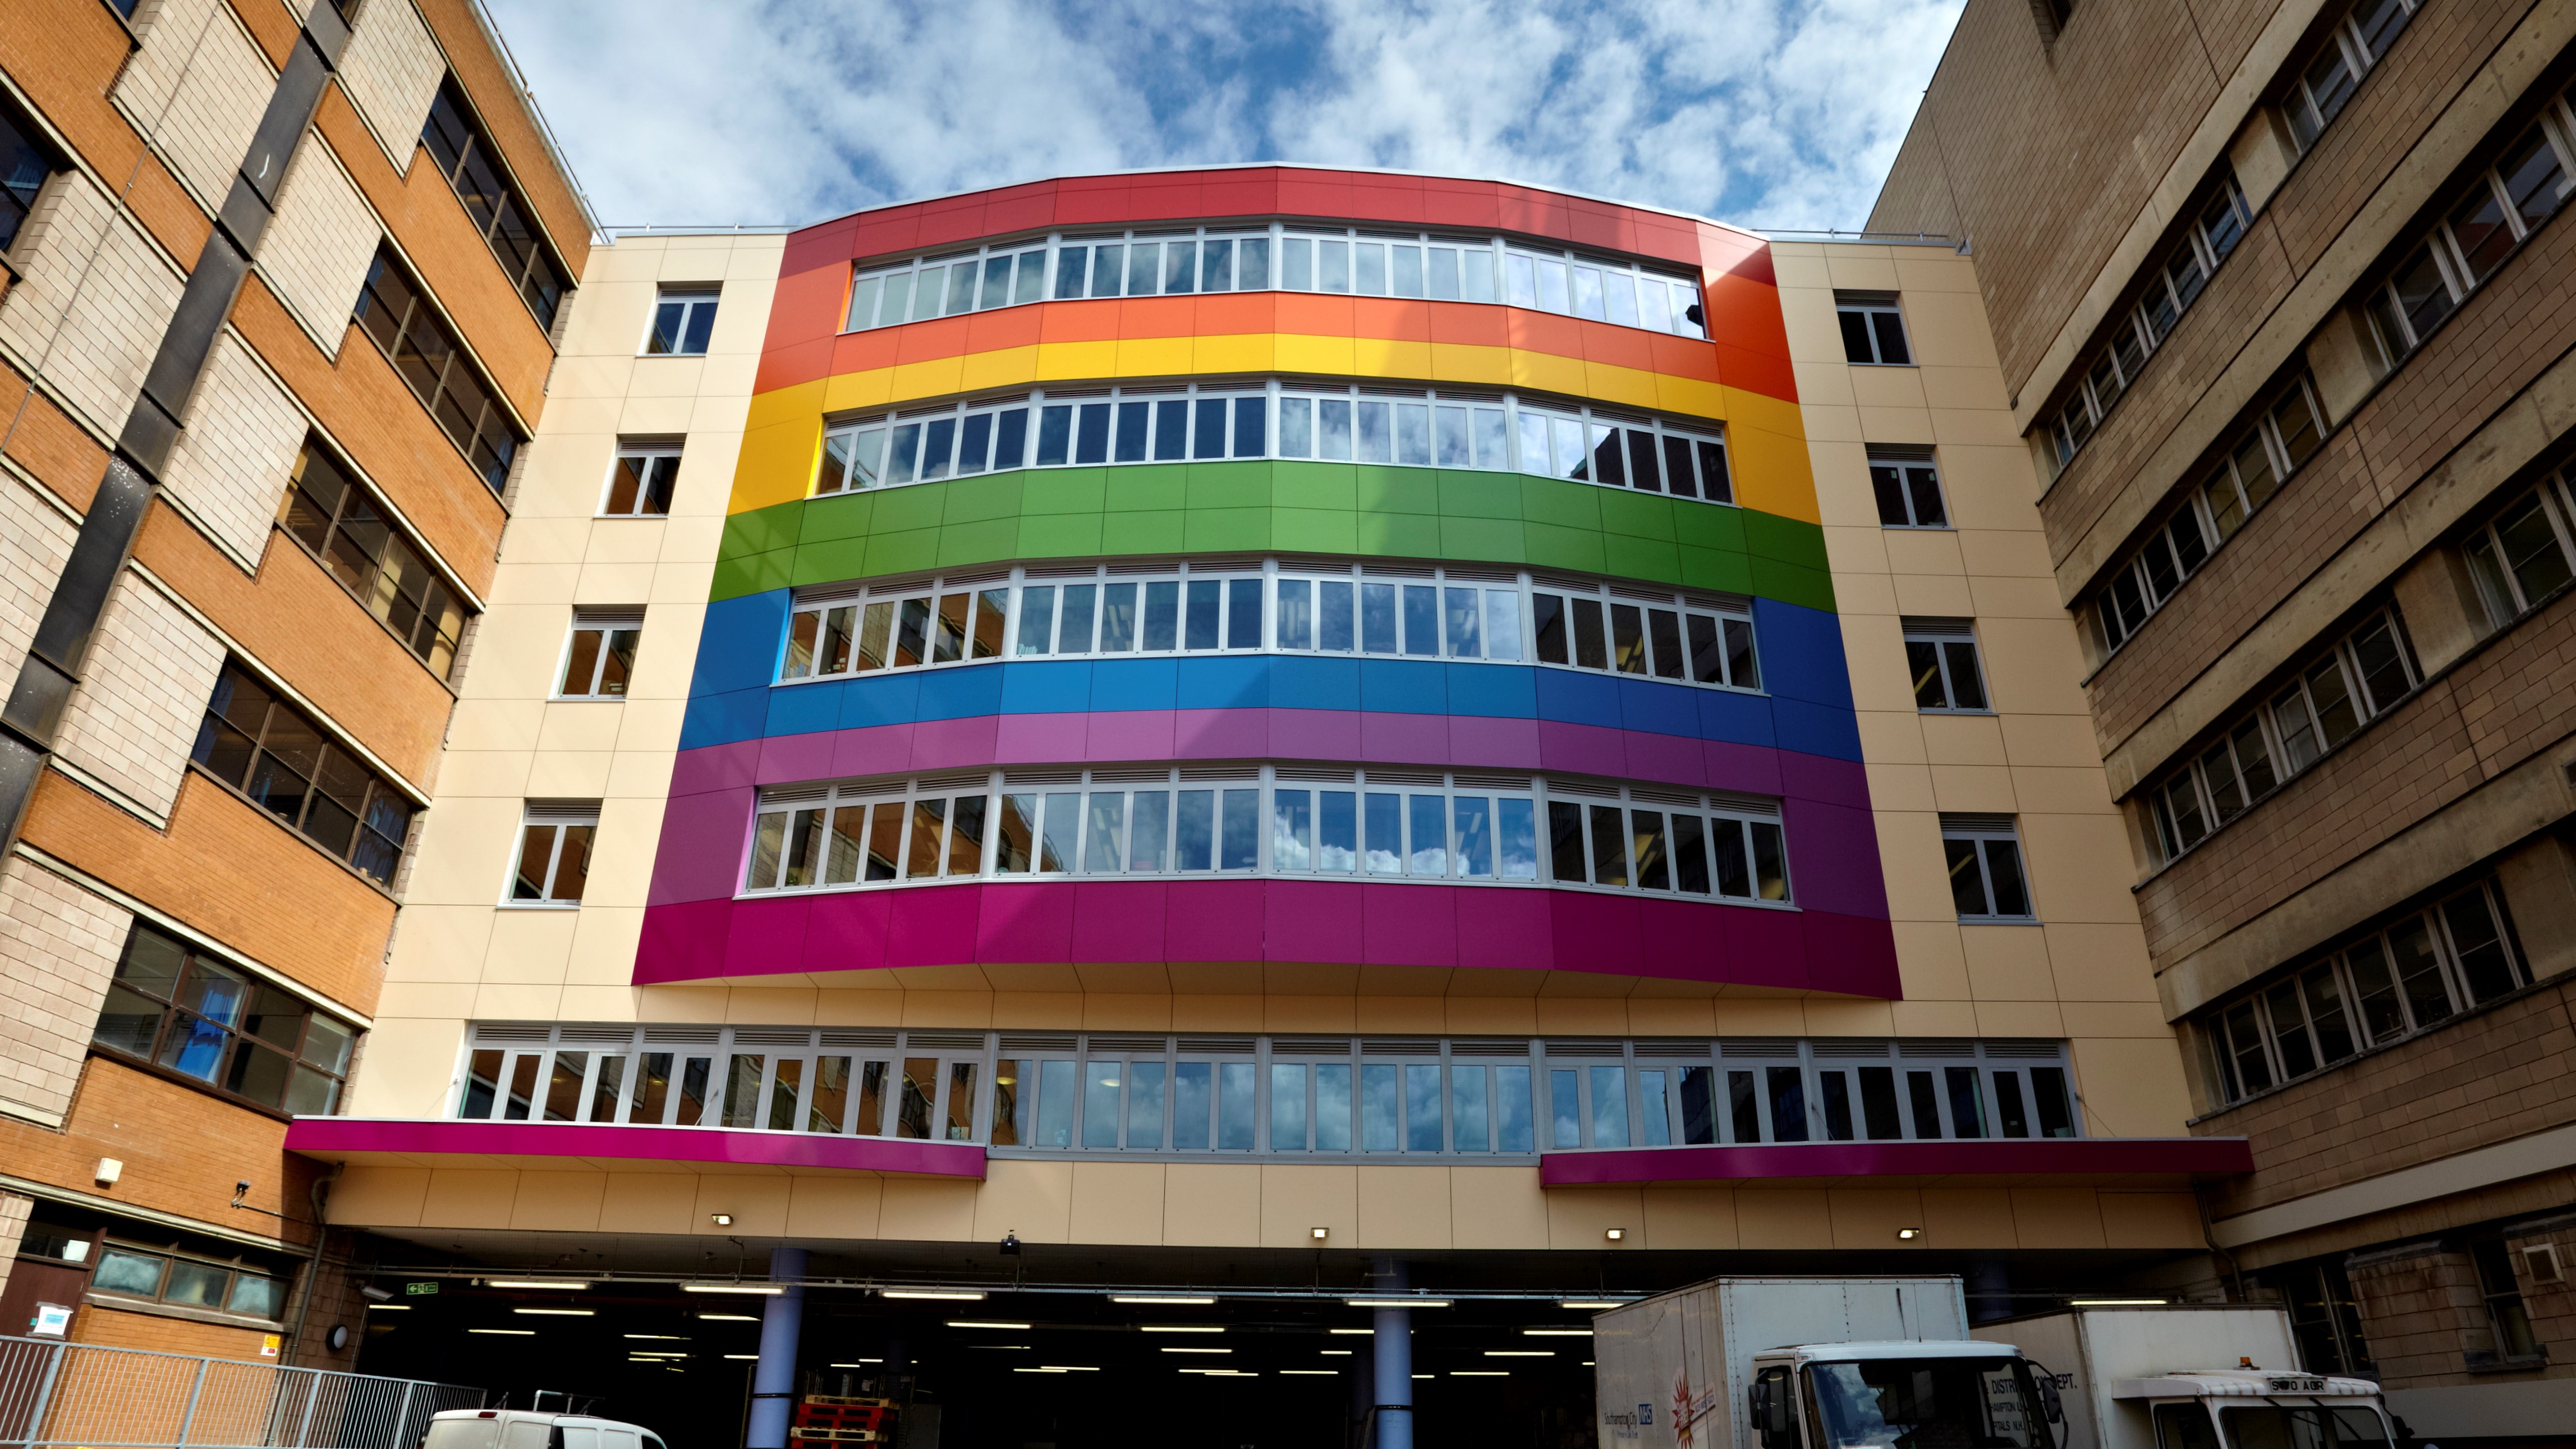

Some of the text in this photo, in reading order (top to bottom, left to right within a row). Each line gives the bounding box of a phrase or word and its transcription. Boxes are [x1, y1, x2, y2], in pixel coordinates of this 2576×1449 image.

[2056, 1373, 2077, 1390] EPT.
[2303, 1381, 2324, 1390] AGR
[1605, 1413, 1629, 1428] Southampton
[1640, 1405, 1652, 1424] NHS
